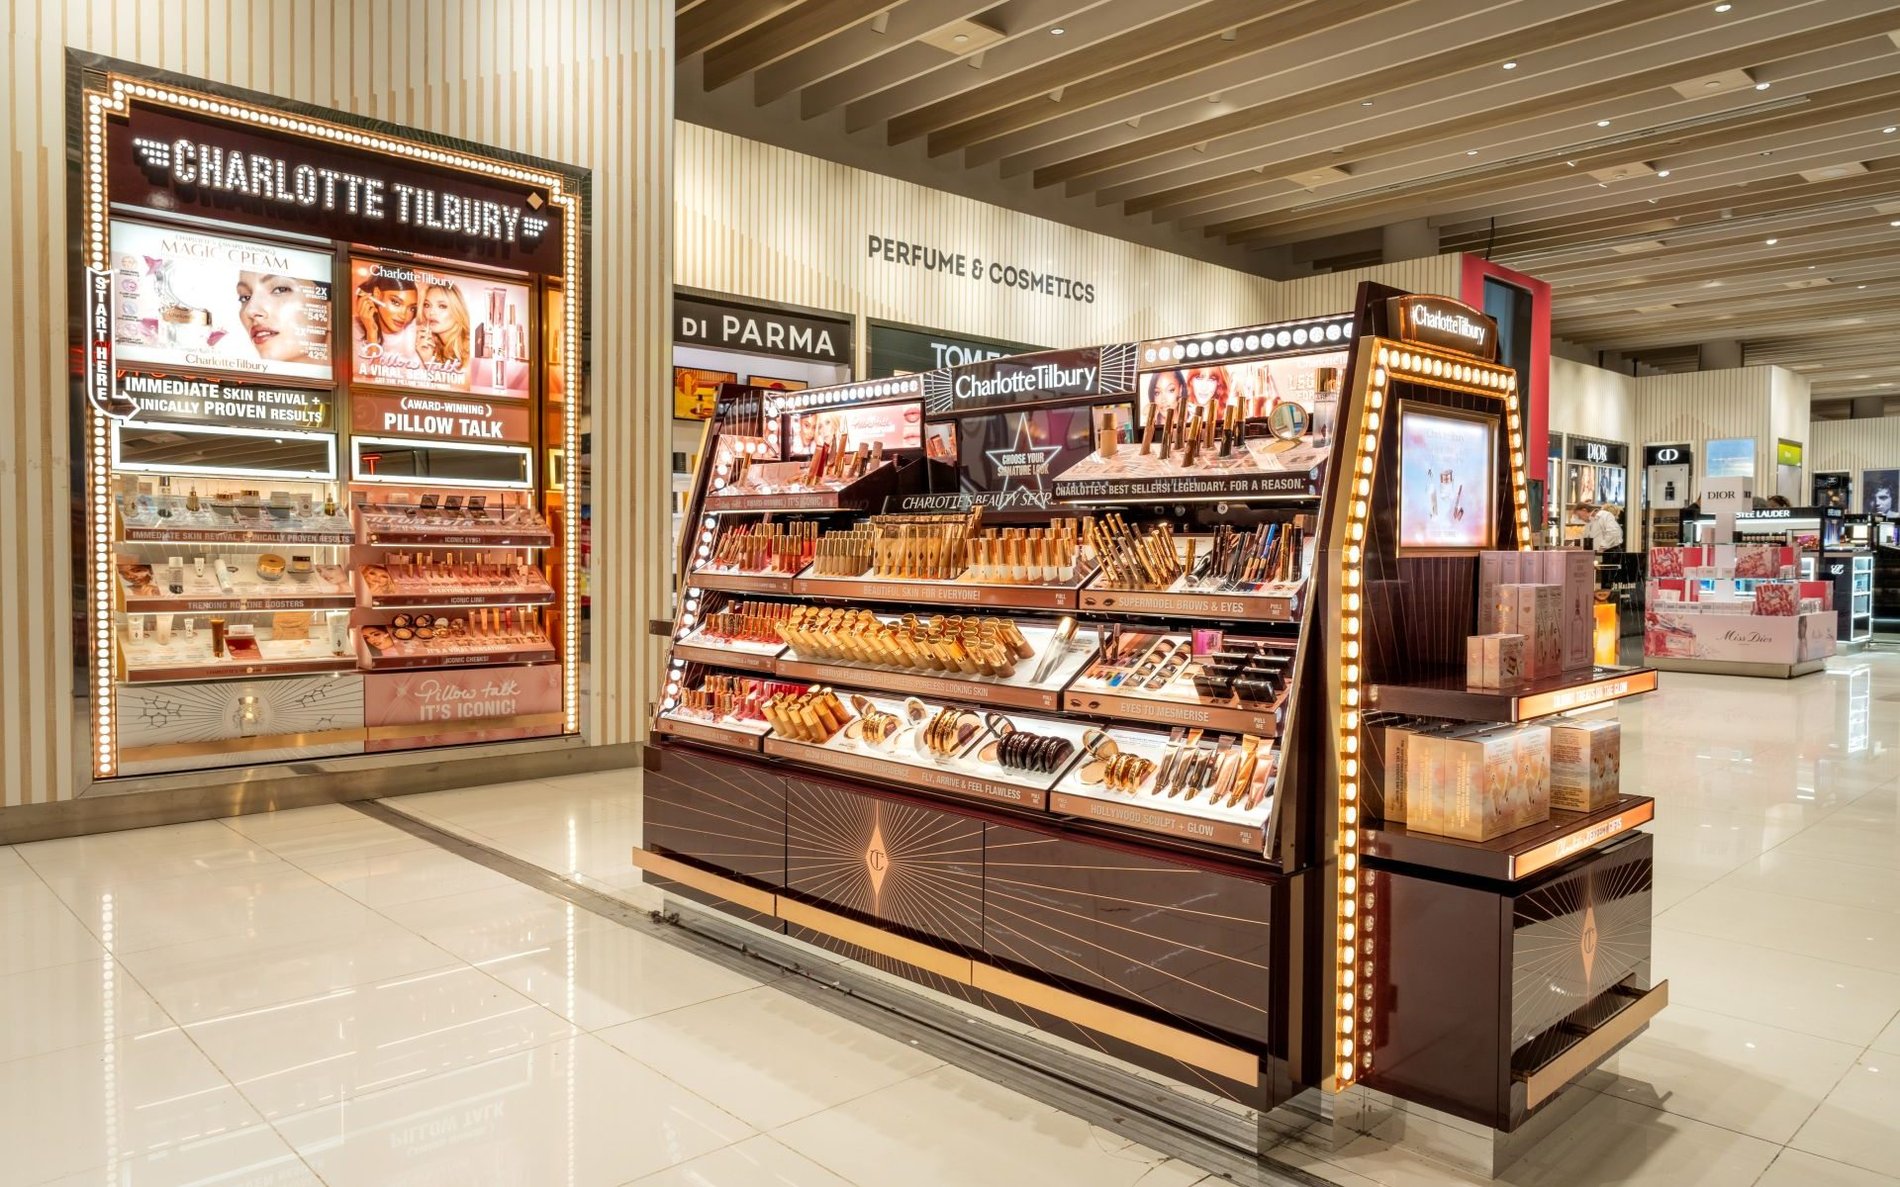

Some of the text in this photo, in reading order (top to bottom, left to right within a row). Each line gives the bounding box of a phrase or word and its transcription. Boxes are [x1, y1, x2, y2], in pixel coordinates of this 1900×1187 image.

[172, 139, 522, 242] CHARLOTTE TILBURY
[162, 240, 289, 269] MAGIC CREAM
[868, 234, 1095, 303] PERFUME & COSMETICS
[95, 275, 109, 401] START HERE
[682, 315, 836, 357] DI PARMA
[125, 376, 219, 399] IMMEDIATE
[223, 387, 254, 402] SKIN
[257, 390, 307, 406] REVIVAL
[204, 402, 266, 420] PROVEN
[270, 408, 322, 424] RESULTS
[384, 412, 503, 439] PILLOW TALK
[1002, 452, 1045, 465] CHOOSE YOUR
[1587, 443, 1607, 463] DIOR
[1055, 483, 1107, 497] CHARLOTTE'S
[1108, 484, 1129, 495] BEST
[1173, 481, 1227, 493] LEGENDARY.
[1229, 480, 1248, 491] FOR
[1251, 480, 1259, 490] A
[1707, 490, 1736, 500] DIOR
[902, 494, 973, 510] CHARLOTTE'S
[975, 492, 1020, 507] BEAUTY
[1756, 509, 1791, 518] LAUDER
[182, 532, 202, 541] SKIN
[287, 534, 317, 544] PROVEN
[319, 534, 350, 544] RESULTS
[863, 585, 981, 601] BEAUTIFUL SKIN FOR EVERYONE!
[1118, 597, 1244, 613] SUPERMODEL BROWS & EYES
[1717, 629, 1773, 643] Miss Dior
[414, 679, 521, 703] Pillow talk
[973, 686, 988, 697] SKIN
[420, 699, 517, 721] IT'S ICONIC!
[1120, 703, 1209, 722] EYES TO MESMERISE
[936, 775, 960, 788] ARRIVE
[960, 780, 967, 789] &
[967, 781, 984, 793] FEEL
[985, 785, 1021, 800] FLAWLESS
[1090, 803, 1142, 824] HOLLYWOOD
[1143, 815, 1176, 830] SCULPT
[1187, 821, 1214, 837] GLOW
